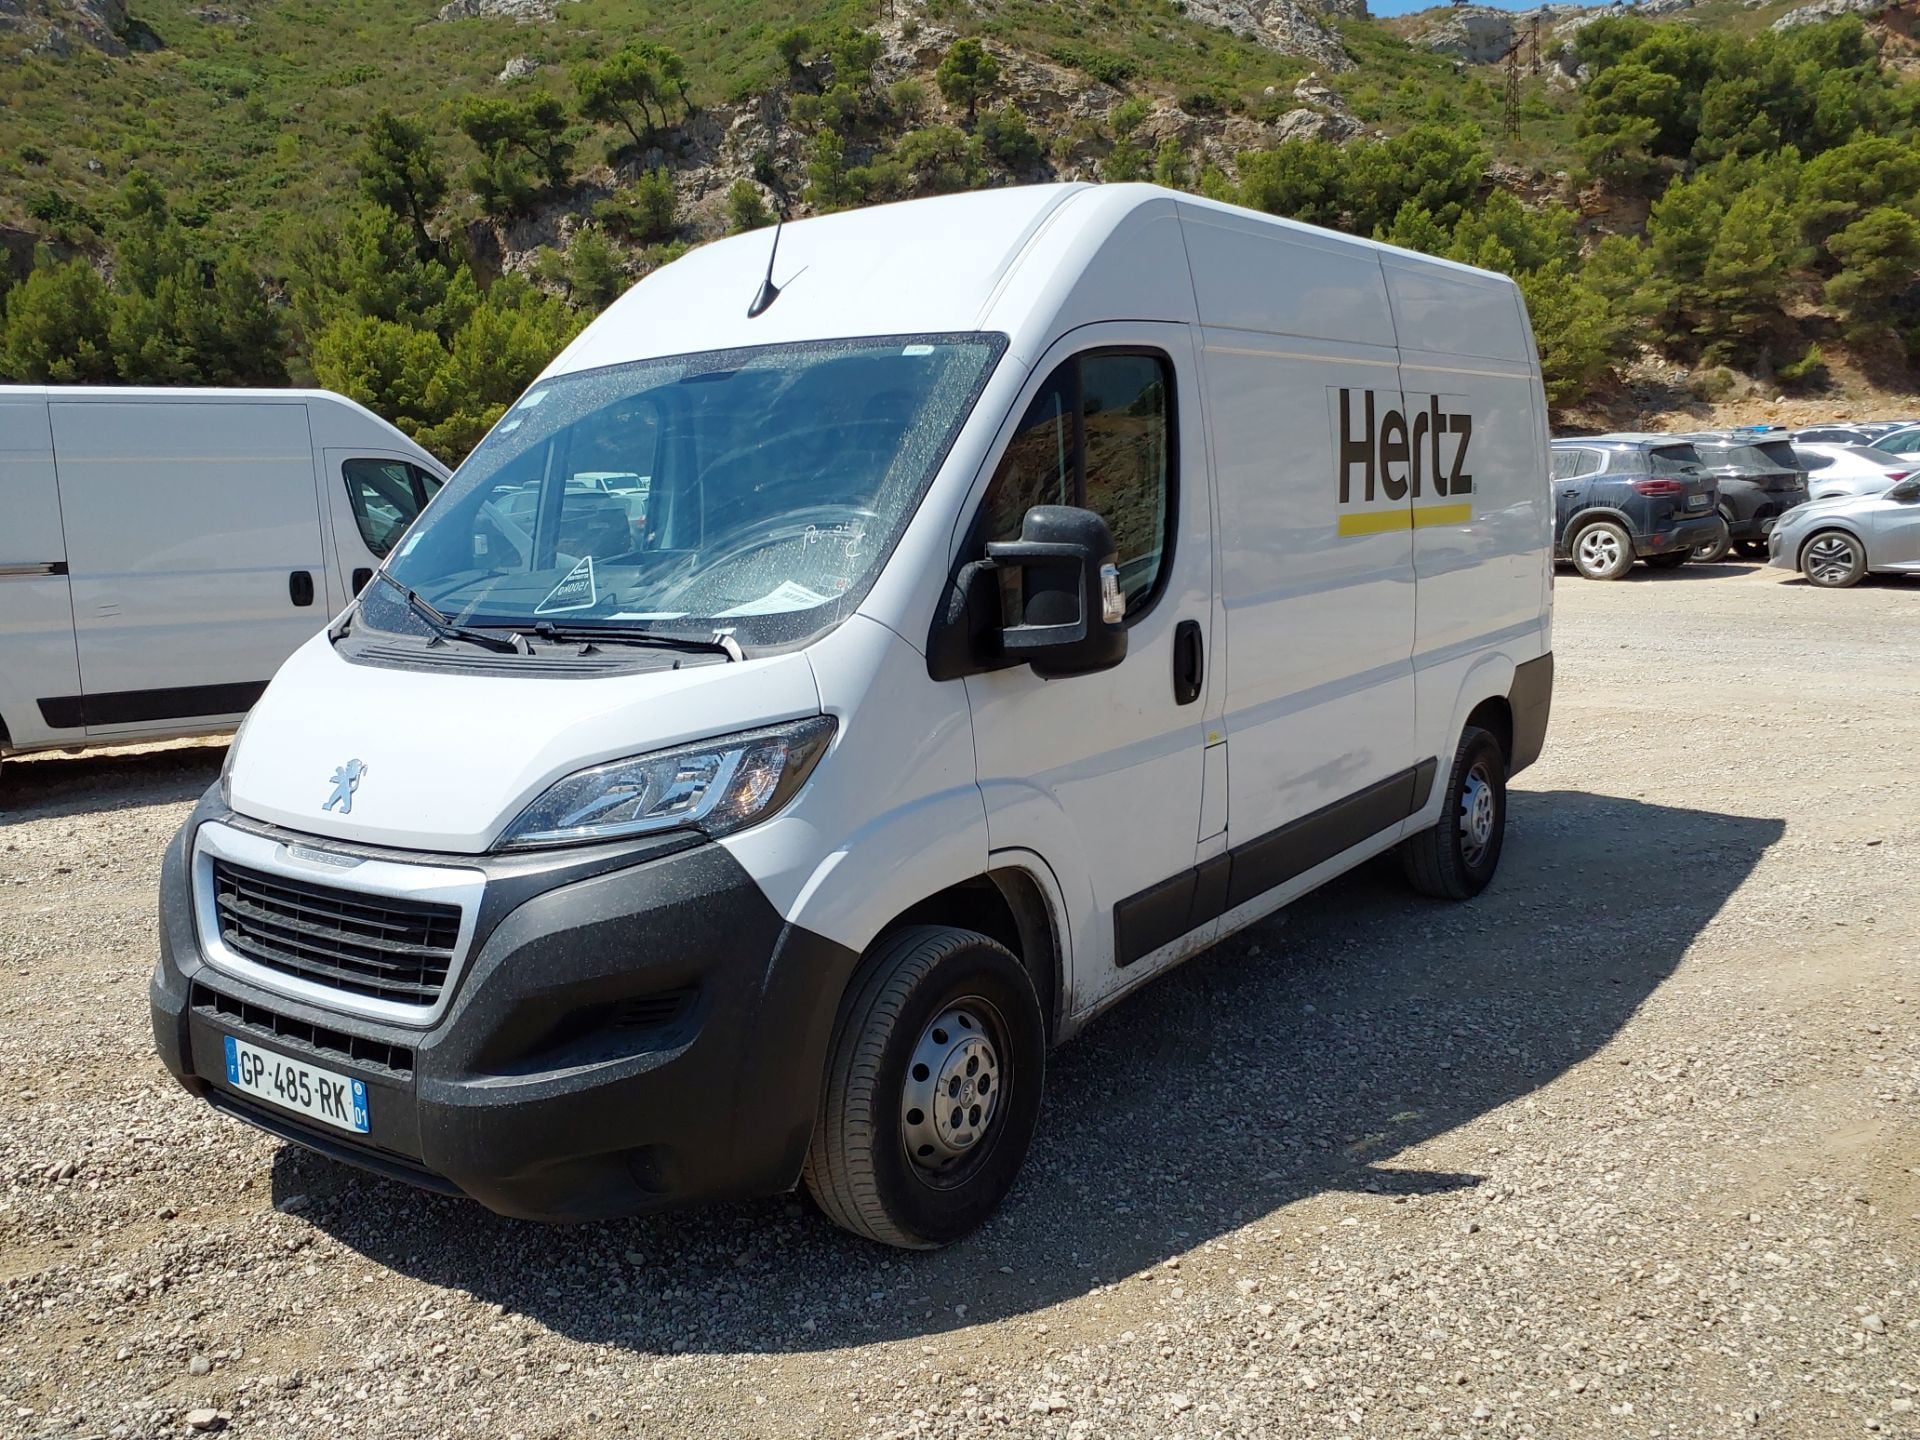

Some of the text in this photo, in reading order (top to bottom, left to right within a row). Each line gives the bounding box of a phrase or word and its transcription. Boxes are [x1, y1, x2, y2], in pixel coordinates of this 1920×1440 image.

[1339, 388, 1472, 503] Hertz
[240, 1050, 349, 1122] GP-485-RK
[354, 1106, 368, 1127] 01
